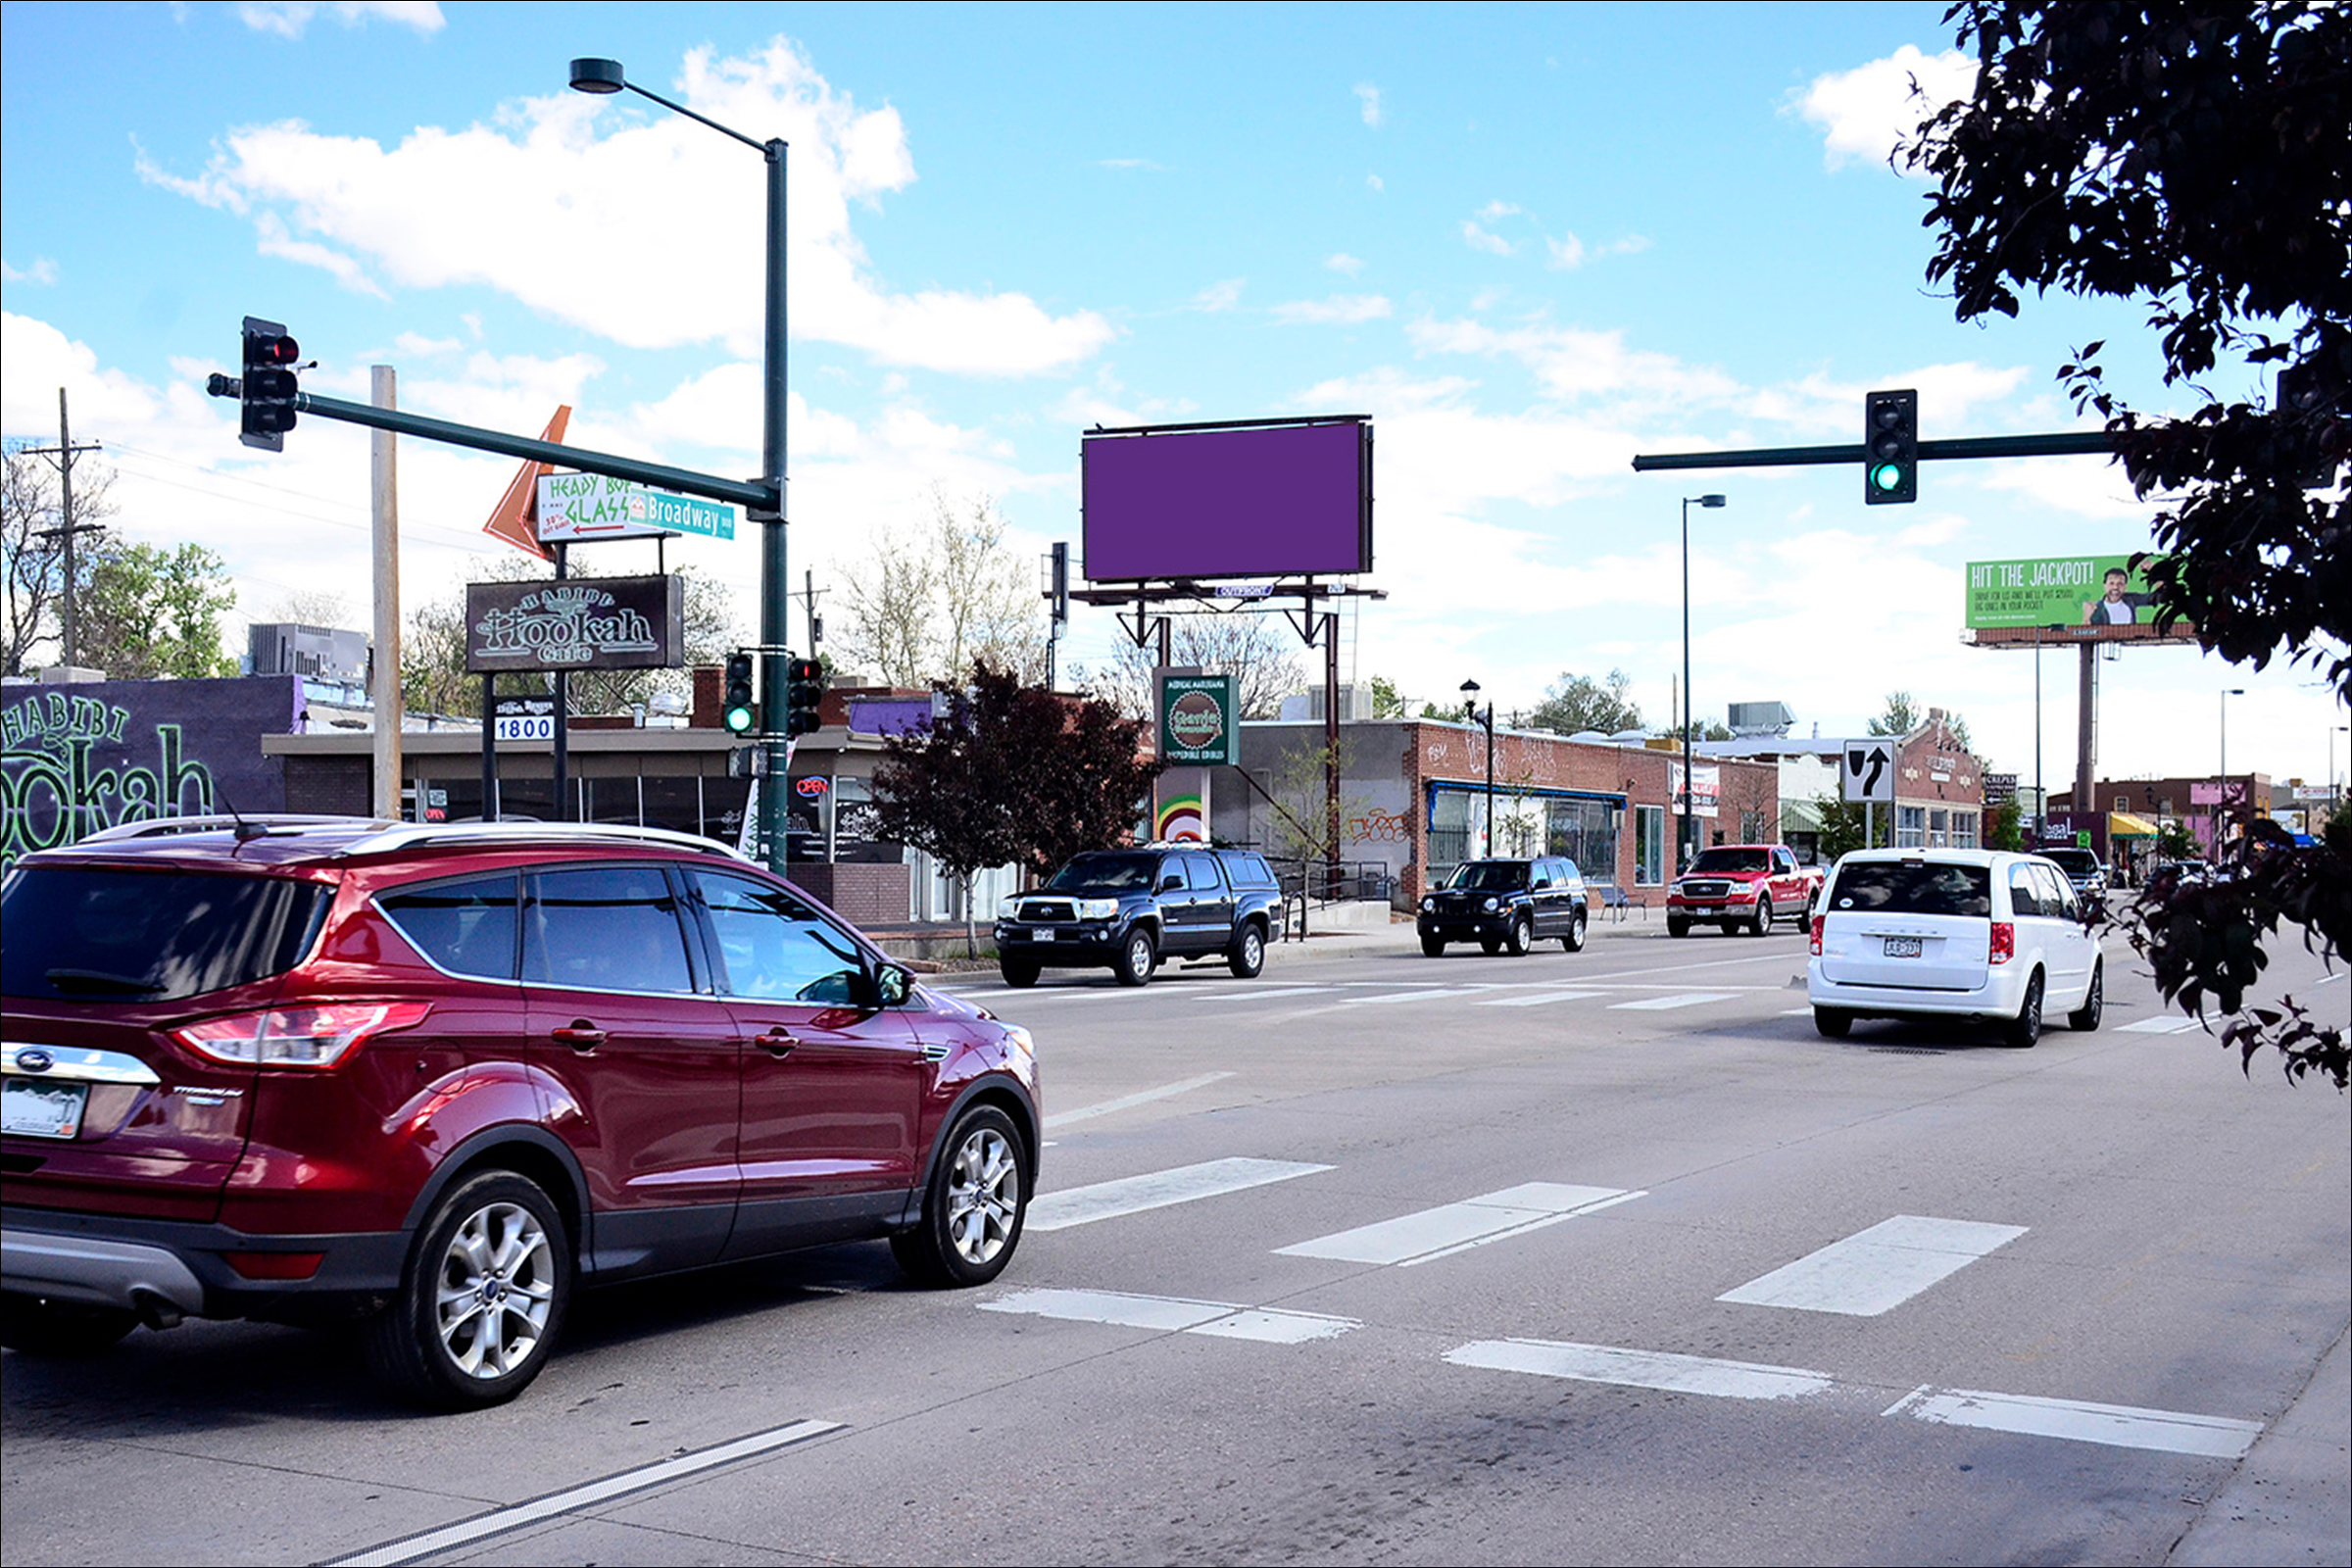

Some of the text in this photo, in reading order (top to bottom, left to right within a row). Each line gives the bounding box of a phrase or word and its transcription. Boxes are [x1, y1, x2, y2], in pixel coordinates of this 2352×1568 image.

[550, 475, 599, 498] HEADY
[565, 497, 629, 524] GLASS
[648, 496, 719, 536] Broadway
[1971, 561, 2094, 588] HIT THE JACKPOT!
[520, 586, 615, 610] HABIBI
[476, 607, 655, 649] Hookah
[538, 643, 593, 662] Cafe
[1, 692, 130, 749] HABIBI
[498, 718, 551, 739] 1800
[796, 779, 829, 793] OPEN
[424, 808, 447, 820] OPEN
